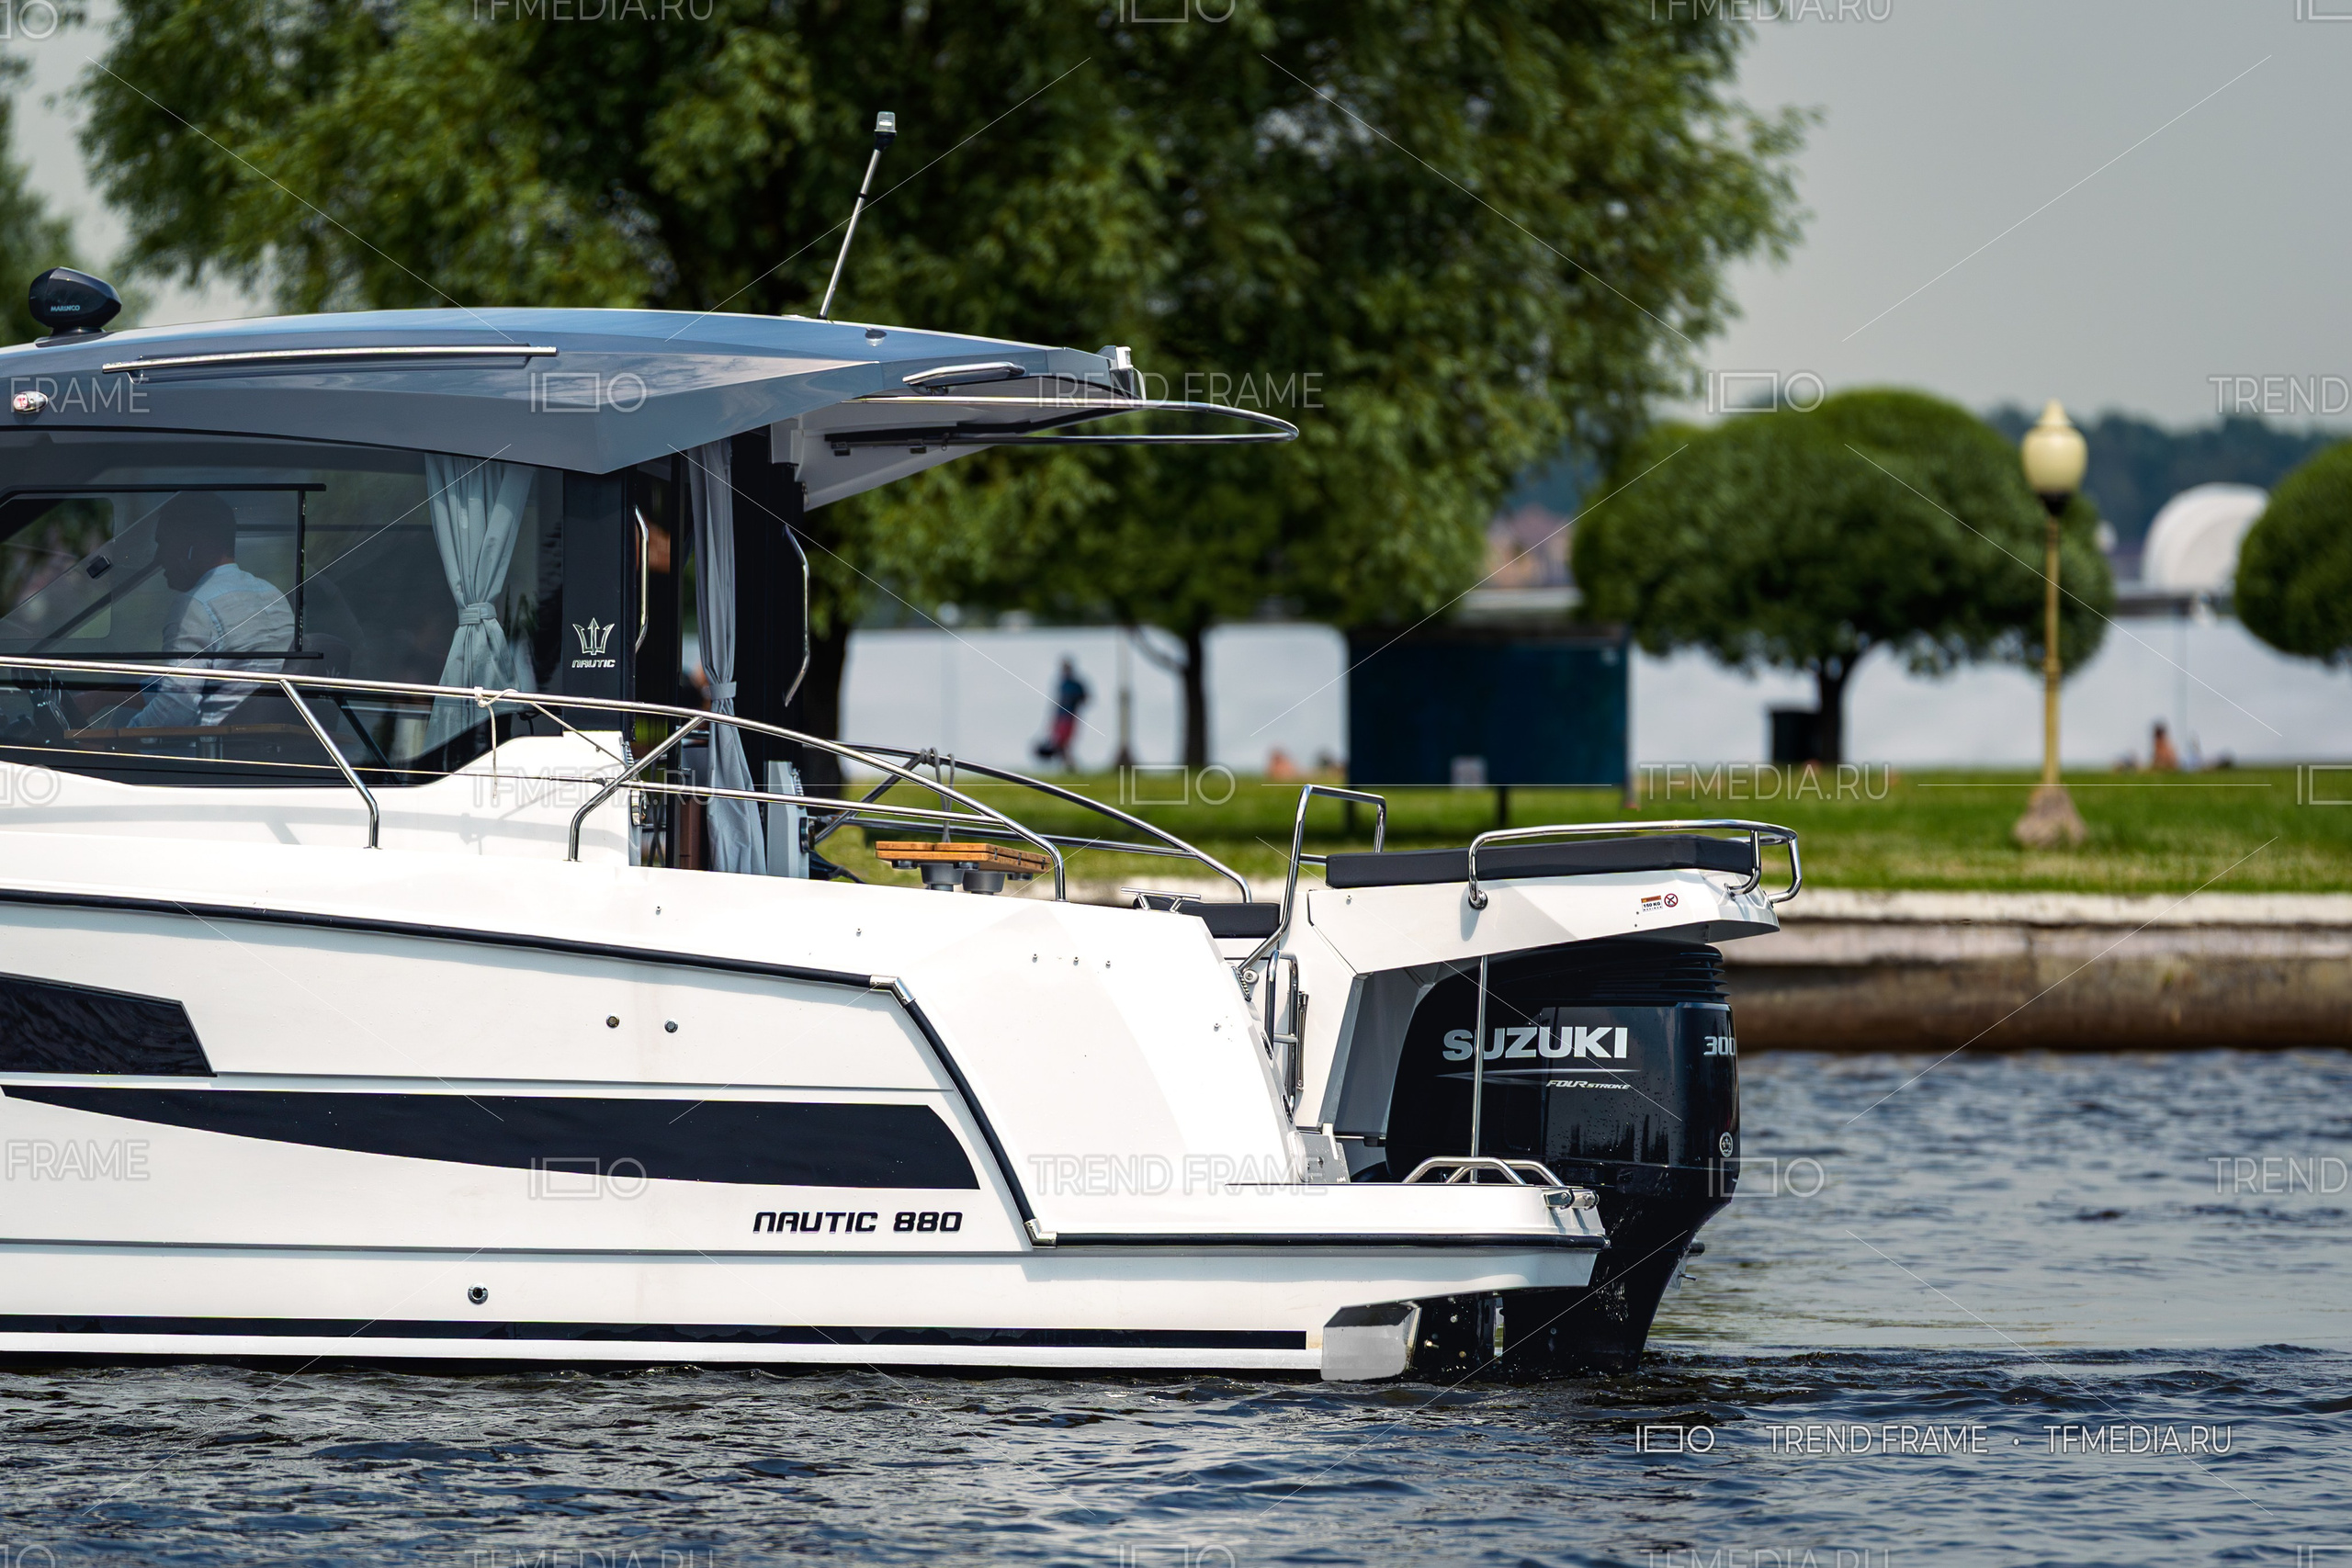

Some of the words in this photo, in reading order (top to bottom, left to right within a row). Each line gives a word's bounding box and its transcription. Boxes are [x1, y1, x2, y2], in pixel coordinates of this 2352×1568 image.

[571, 659, 616, 668] NAUTIC
[1442, 1026, 1628, 1060] SUZUKI
[1703, 1035, 1736, 1055] 300
[752, 1212, 878, 1234] NAUTIC
[893, 1212, 963, 1234] 880
